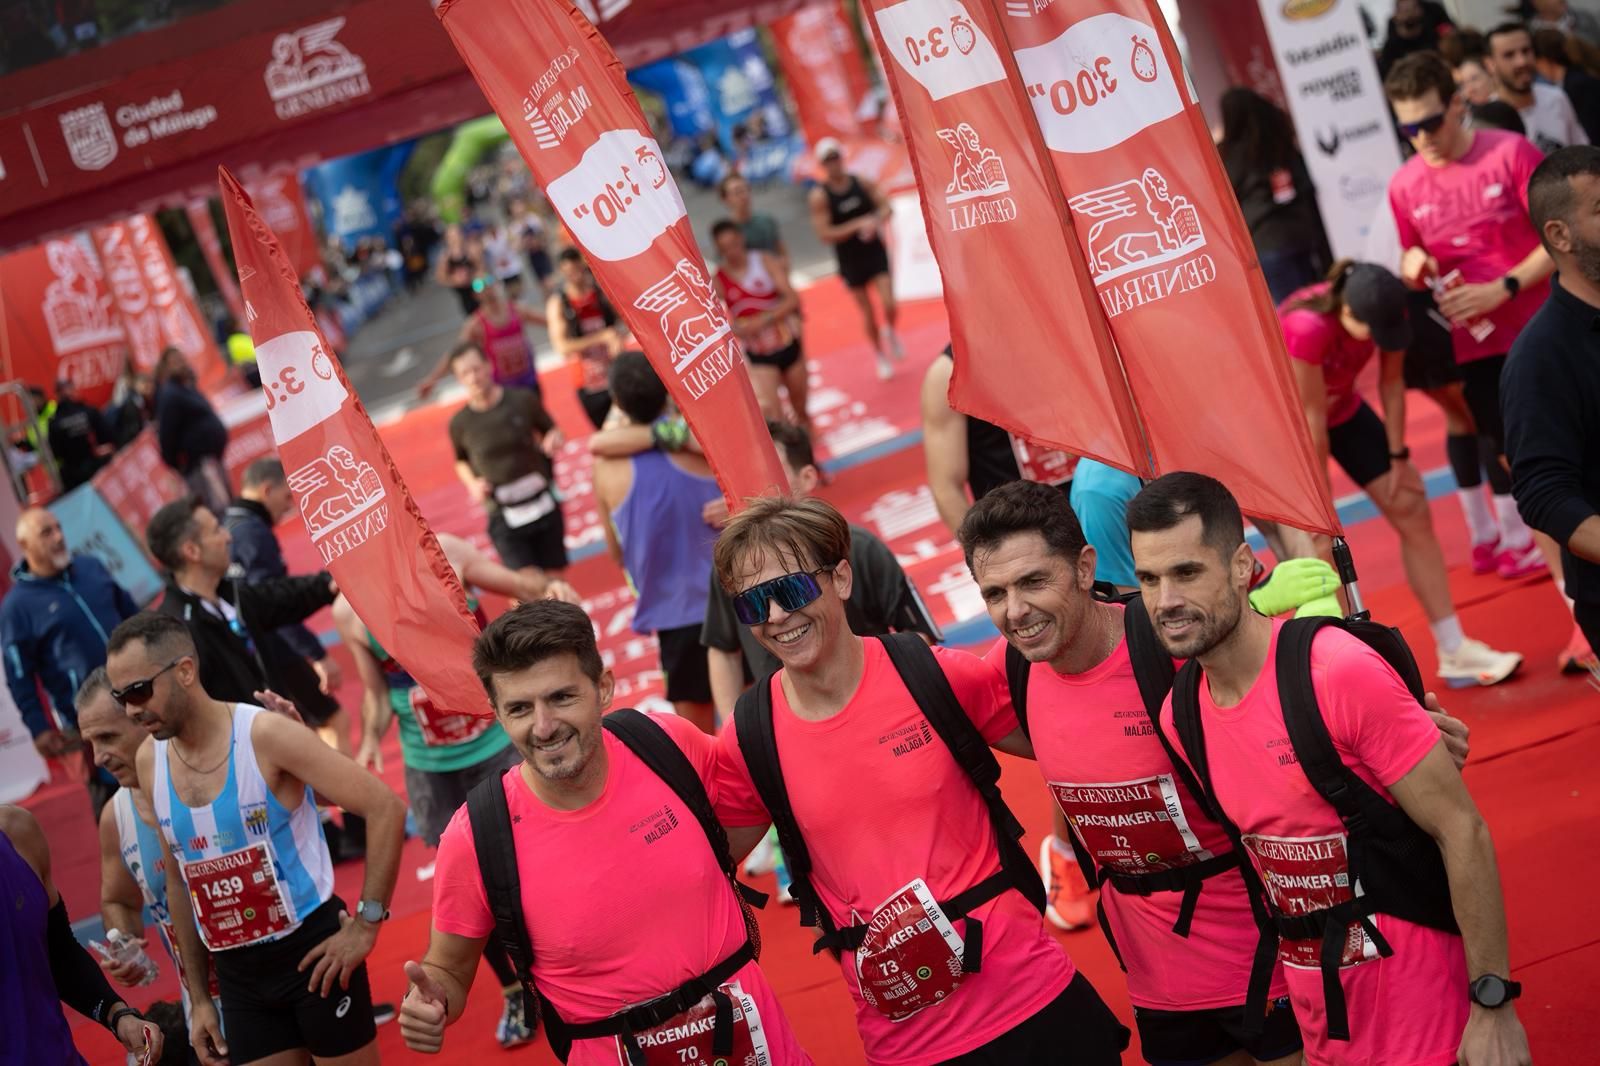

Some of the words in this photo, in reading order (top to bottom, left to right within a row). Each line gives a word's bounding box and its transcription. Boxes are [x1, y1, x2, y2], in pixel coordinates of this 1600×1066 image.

[123, 126, 150, 148] de
[1077, 784, 1152, 804] GENERALI
[1167, 802, 1179, 818] BOX
[1076, 811, 1156, 828] PACEMAKER
[1111, 834, 1131, 848] 72
[1264, 842, 1335, 861] GENERALI
[197, 851, 253, 875] GENERALI
[202, 876, 244, 900] 1439
[926, 905, 940, 921] BOX
[880, 960, 899, 976] 73
[741, 996, 753, 1013] BOX
[636, 1015, 716, 1049] PACEMAKE
[677, 1046, 699, 1063] 70
